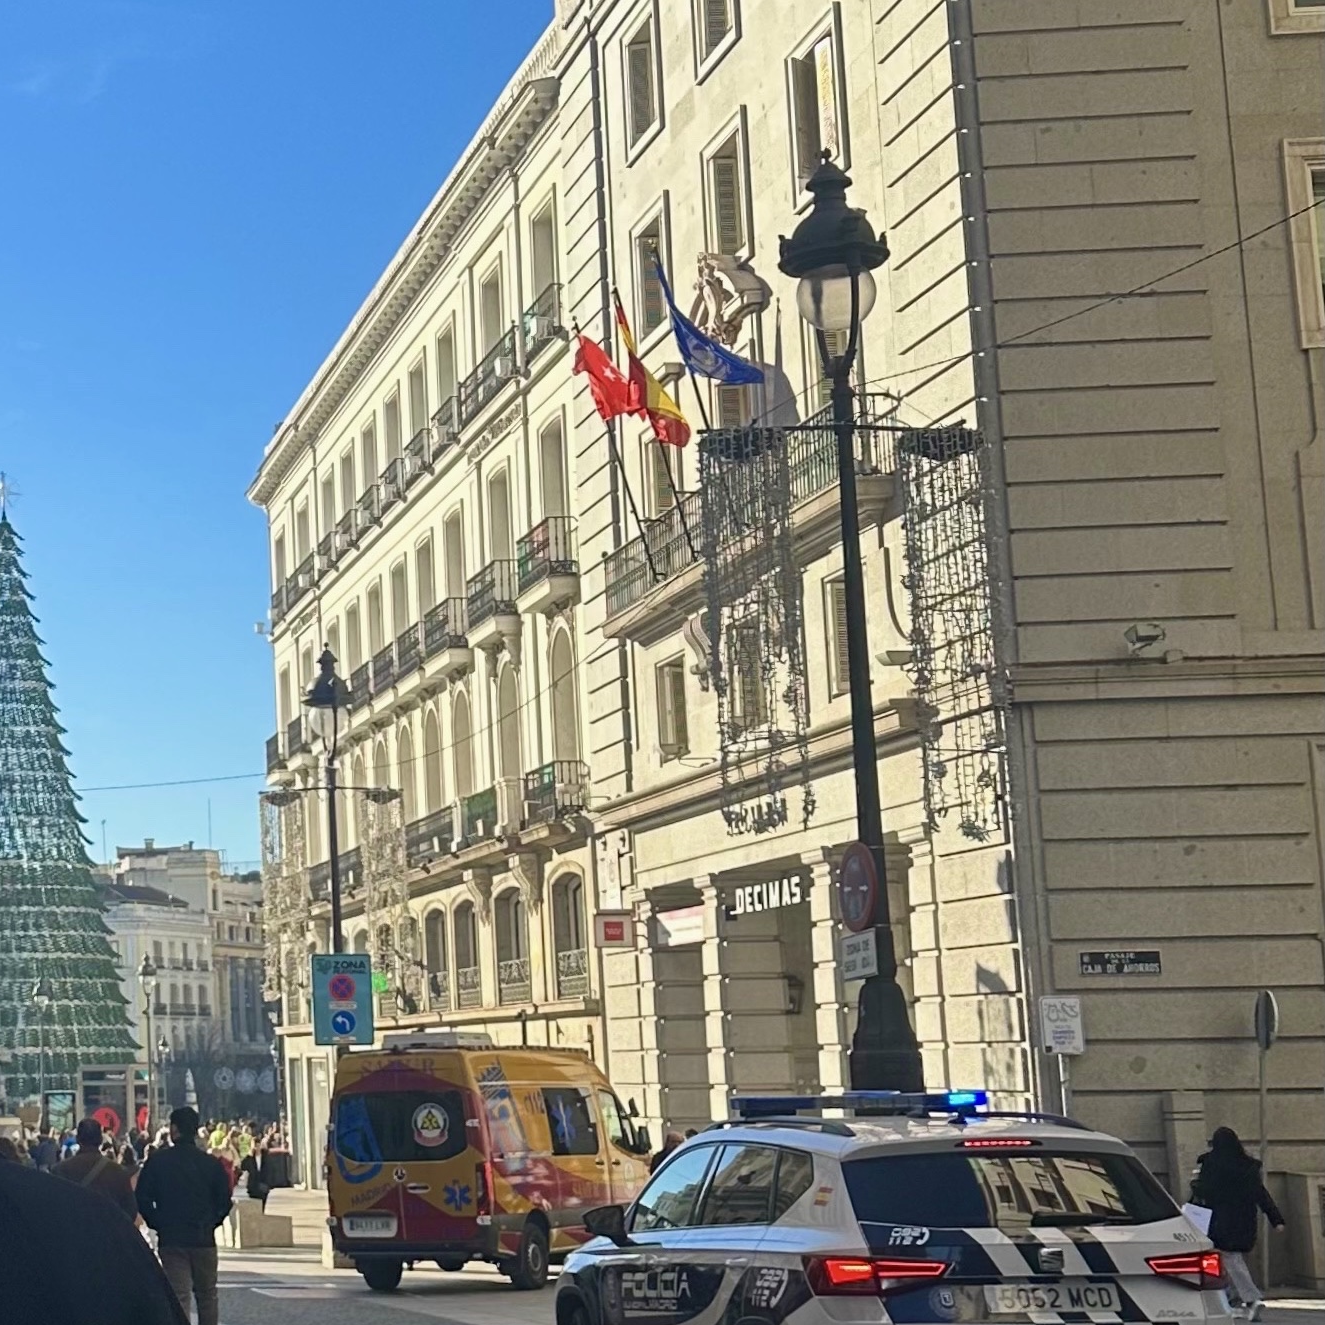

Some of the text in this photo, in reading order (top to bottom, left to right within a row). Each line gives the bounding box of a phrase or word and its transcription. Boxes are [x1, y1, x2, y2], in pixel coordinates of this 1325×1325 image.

[333, 960, 366, 969] ZONA
[1082, 964, 1103, 975] CAJA
[1106, 964, 1119, 974] DE
[1001, 1287, 1113, 1309] 5052 MCD
